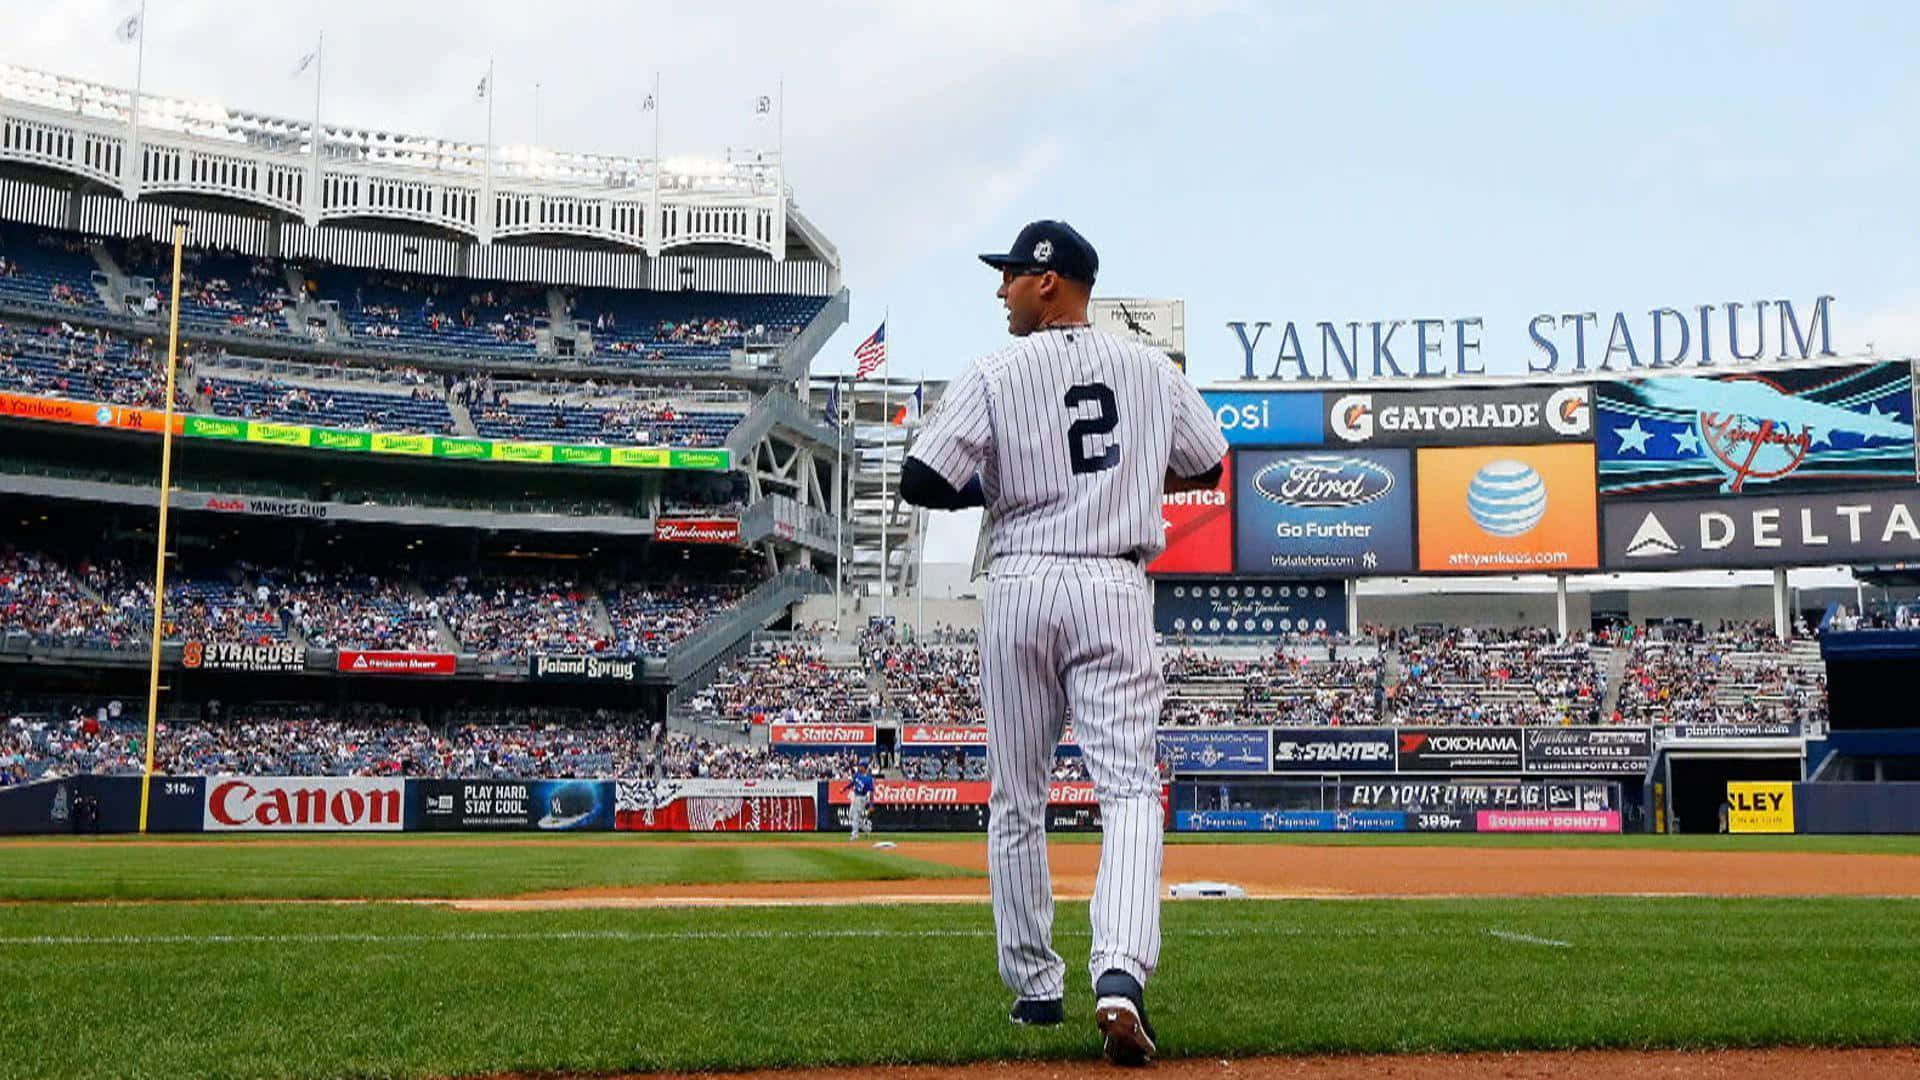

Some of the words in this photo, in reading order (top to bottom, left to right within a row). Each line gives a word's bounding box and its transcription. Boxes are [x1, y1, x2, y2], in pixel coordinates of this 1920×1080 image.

[1227, 318, 1485, 381] YANKEE
[1528, 295, 1838, 374] STADIUM
[1379, 403, 1539, 430] GATORADE
[1064, 383, 1120, 475] 2
[1281, 465, 1366, 498] Ford
[250, 501, 297, 515] YANKEES
[300, 504, 327, 518] CLUB
[1277, 523, 1302, 537] Go
[1306, 521, 1372, 537] Further
[1700, 504, 1920, 549] DELTA
[204, 642, 306, 663] SYRACUSE
[538, 656, 585, 677] Poland
[587, 657, 636, 680] Spring
[963, 729, 988, 741] Far
[1428, 737, 1517, 750] YOKOHAMA
[1303, 742, 1389, 760] STARTER
[1545, 747, 1630, 756] COLLECTIBLES
[1529, 762, 1647, 770] STEINERSPORTS.COM
[464, 786, 492, 799] PLAY
[496, 786, 529, 799] HARD.
[873, 784, 915, 801] State
[917, 785, 957, 801] Farm
[1352, 785, 1384, 804] FLY
[209, 780, 400, 826] Canon
[465, 800, 492, 814] STAY
[496, 800, 528, 814] COOL.
[1499, 817, 1552, 827] DUNKIN'
[1553, 817, 1607, 827] DONUTS
